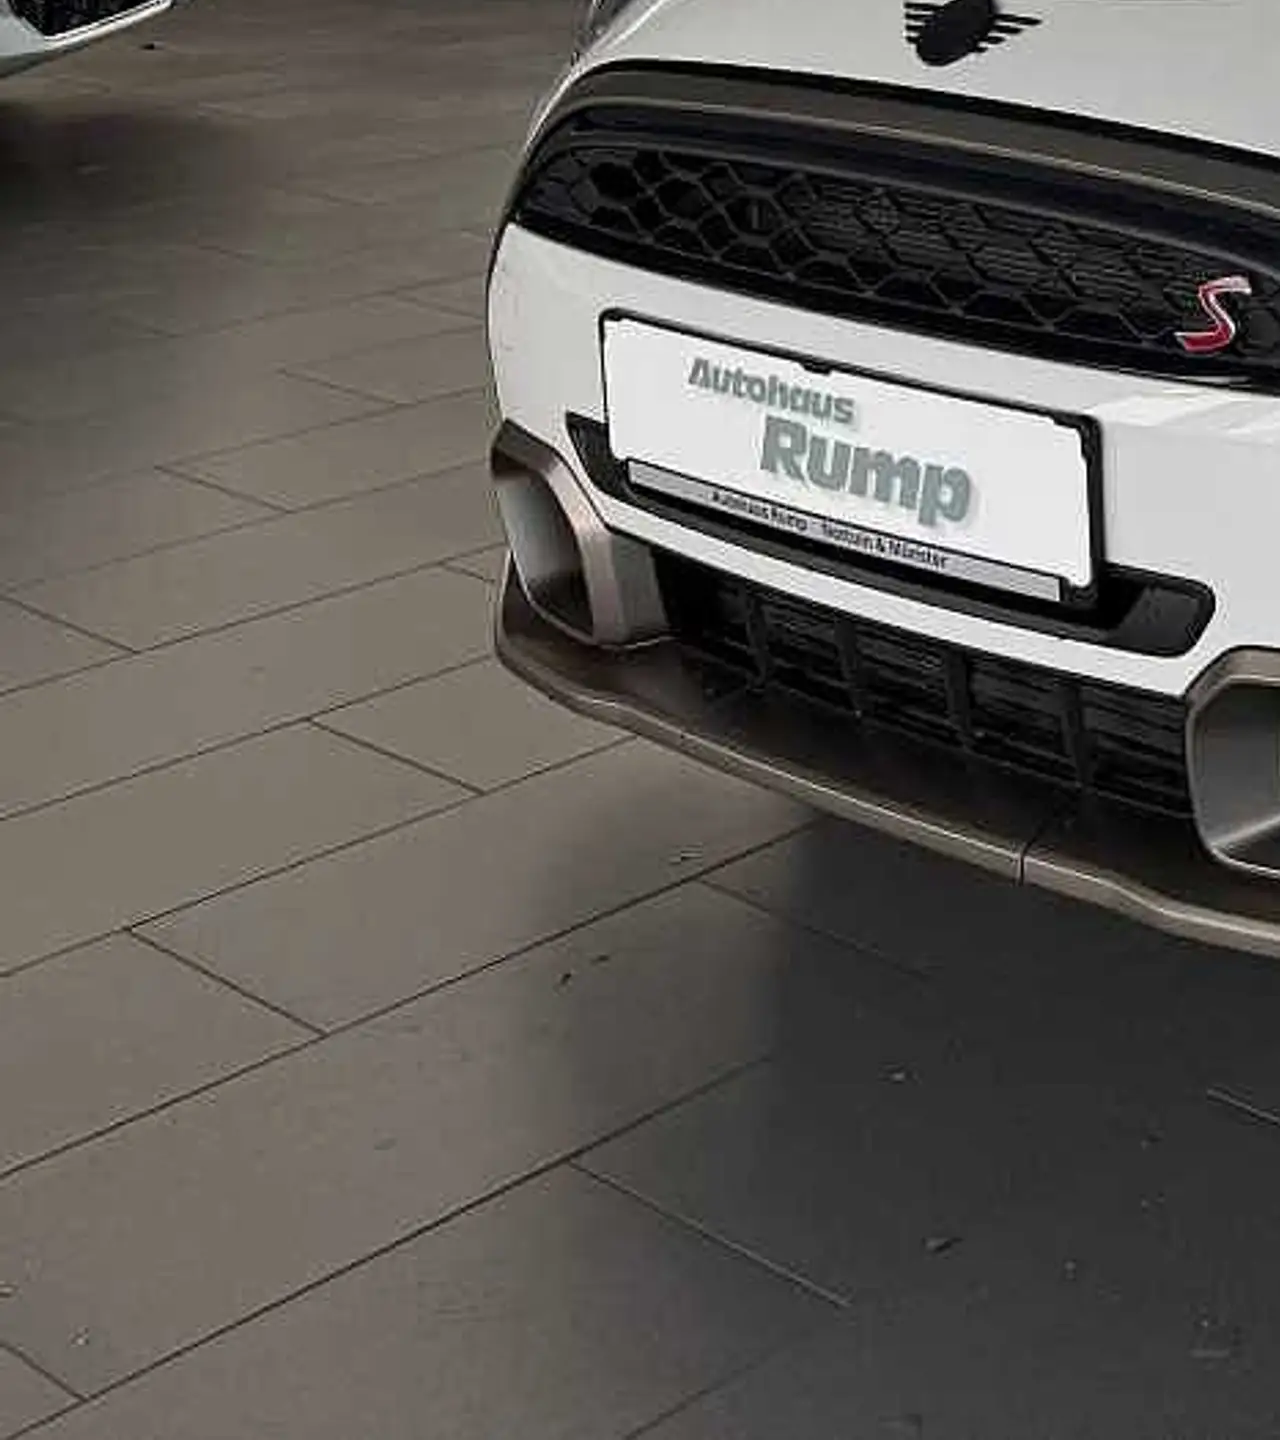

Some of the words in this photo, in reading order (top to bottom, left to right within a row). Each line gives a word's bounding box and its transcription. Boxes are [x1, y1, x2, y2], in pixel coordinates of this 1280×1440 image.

[1174, 275, 1252, 353] S
[688, 357, 855, 423] Autohaus
[760, 414, 971, 526] Rump
